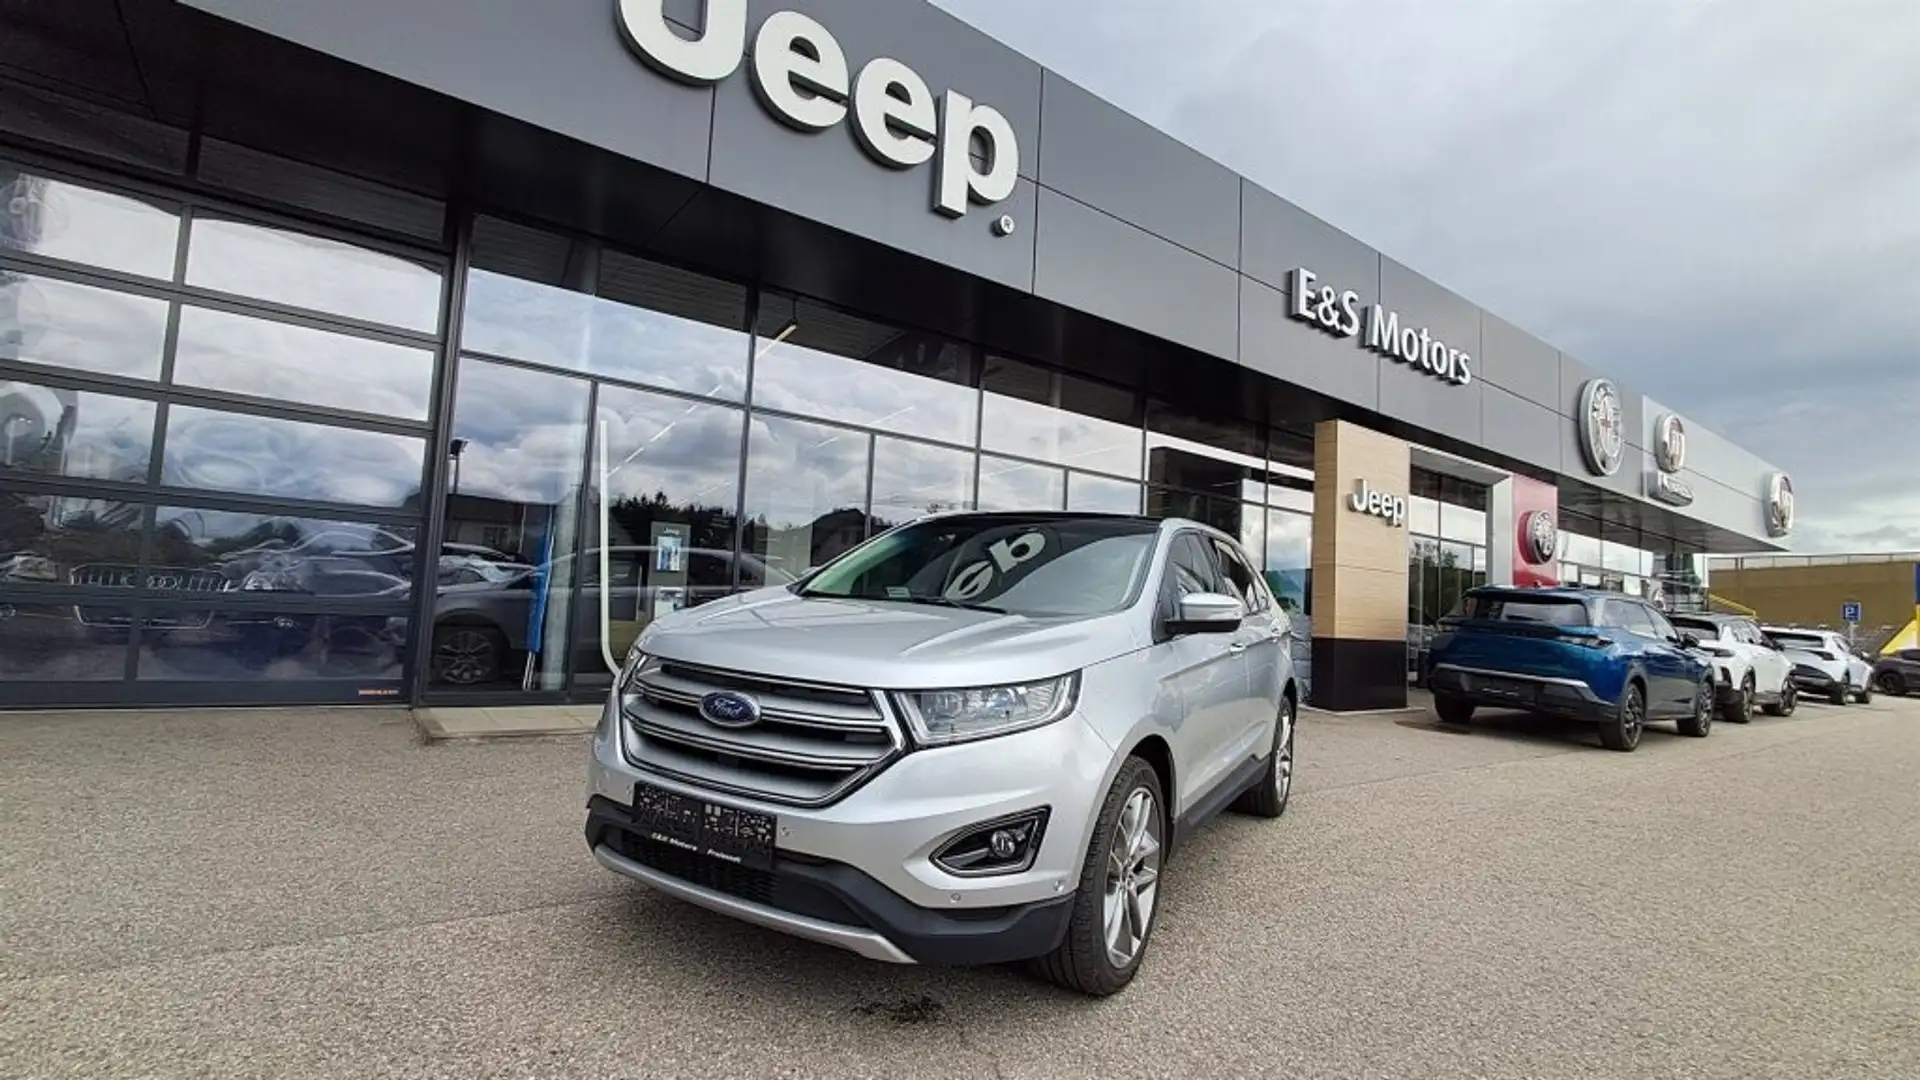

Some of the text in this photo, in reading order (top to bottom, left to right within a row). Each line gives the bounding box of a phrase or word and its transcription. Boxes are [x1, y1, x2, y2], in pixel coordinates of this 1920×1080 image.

[1295, 267, 1472, 385] E&S Motors
[1349, 476, 1405, 526] Jeep
